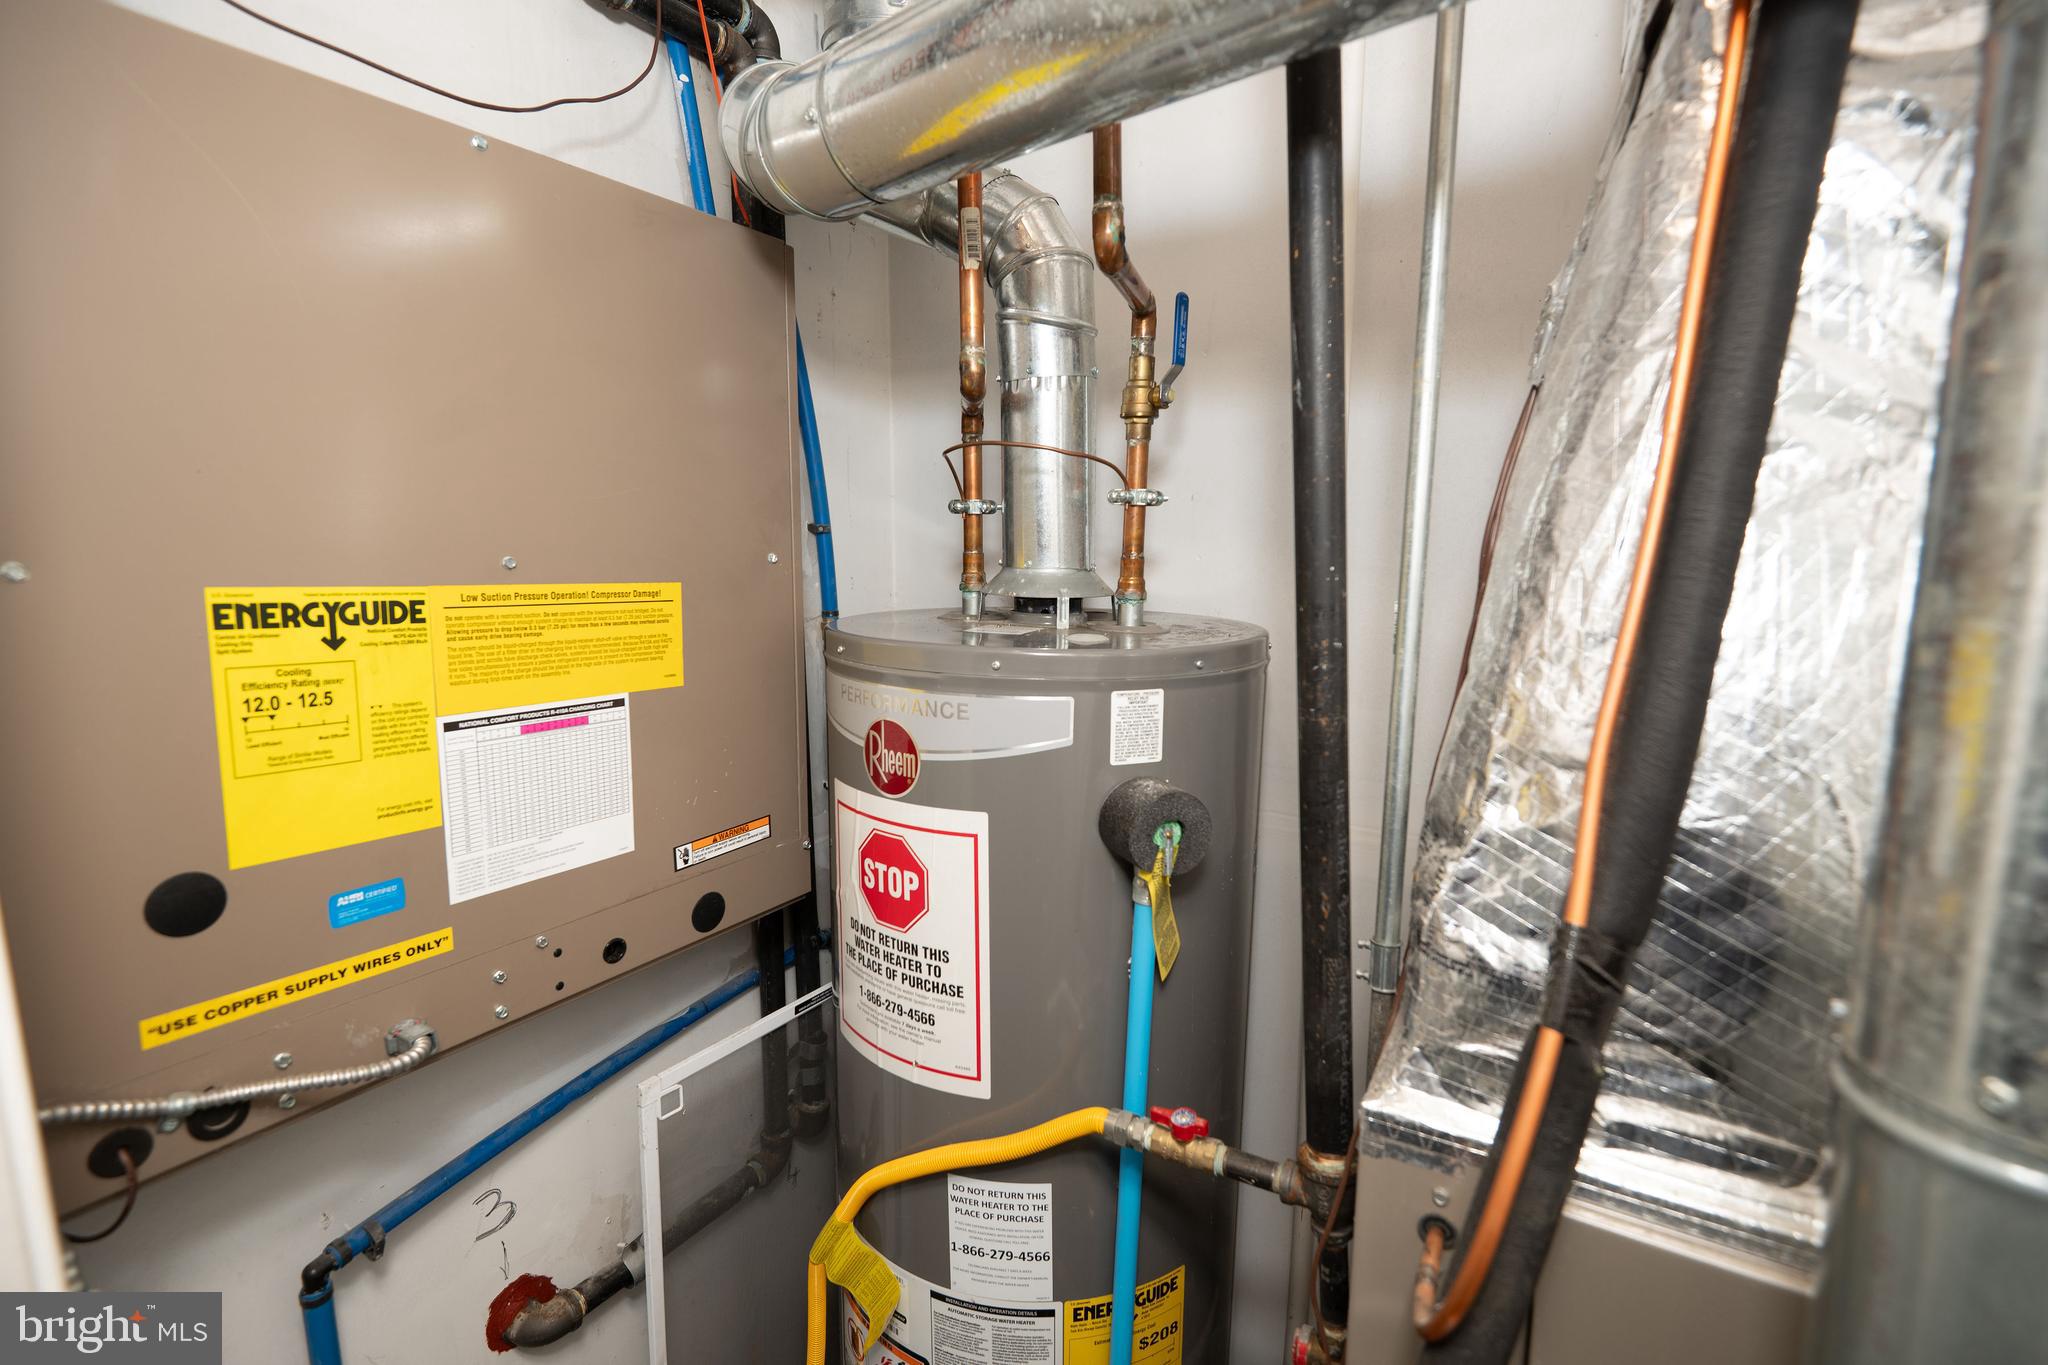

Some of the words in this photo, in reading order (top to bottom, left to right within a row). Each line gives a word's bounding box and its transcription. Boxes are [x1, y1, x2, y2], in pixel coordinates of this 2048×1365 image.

[460, 593, 475, 602] Low
[480, 592, 512, 602] Suction
[514, 591, 549, 601] Pressure
[550, 591, 589, 601] Operation!
[591, 590, 631, 600] Compressor
[633, 589, 662, 599] Damage!
[212, 600, 426, 630] ENERGYGUIDE
[275, 668, 312, 677] Cooling
[241, 682, 288, 691] Efficiency
[291, 679, 321, 688] Rating
[243, 696, 280, 713] 12.0
[298, 691, 333, 708] 12.5
[841, 684, 970, 720] PERFORMANCE
[458, 719, 489, 728] NATIONAL
[490, 715, 519, 724] COMFORT
[520, 711, 550, 720] PRODUCTS
[868, 720, 917, 783] Rheem
[718, 824, 750, 841] WARNING
[863, 857, 920, 902] STOP
[850, 917, 859, 933] DO
[860, 923, 876, 941] NOT
[878, 932, 919, 957] RETURN
[922, 946, 950, 964] THIS
[854, 934, 880, 959] WATER
[883, 949, 922, 974] HEATER
[926, 963, 941, 978] TO
[845, 941, 857, 960] THE
[858, 952, 883, 976] PLACE
[885, 966, 898, 982] OF
[901, 972, 965, 999] PURCHASE
[204, 990, 279, 1021] COPPER
[284, 968, 348, 996] SUPPLY
[353, 951, 401, 974] WIRES
[859, 985, 936, 1027] 1-866-279-4566
[952, 1183, 965, 1192] DO
[967, 1186, 985, 1196] NOT
[987, 1190, 1024, 1199] RETURN
[1026, 1192, 1047, 1200] THIS
[950, 1194, 979, 1207] WATER
[981, 1201, 1015, 1211] HEATER
[1031, 1204, 1049, 1212] THE
[955, 1207, 981, 1218] PLACE
[996, 1214, 1044, 1223] PURCHASE
[951, 1242, 1051, 1262] 1-866-279-4566
[945, 1297, 977, 1310] INSTALLATION
[990, 1307, 1017, 1316] OPERATION
[947, 1307, 975, 1319] AUTOMATIC
[975, 1314, 998, 1323] STORAGE
[1139, 1320, 1178, 1350] $208
